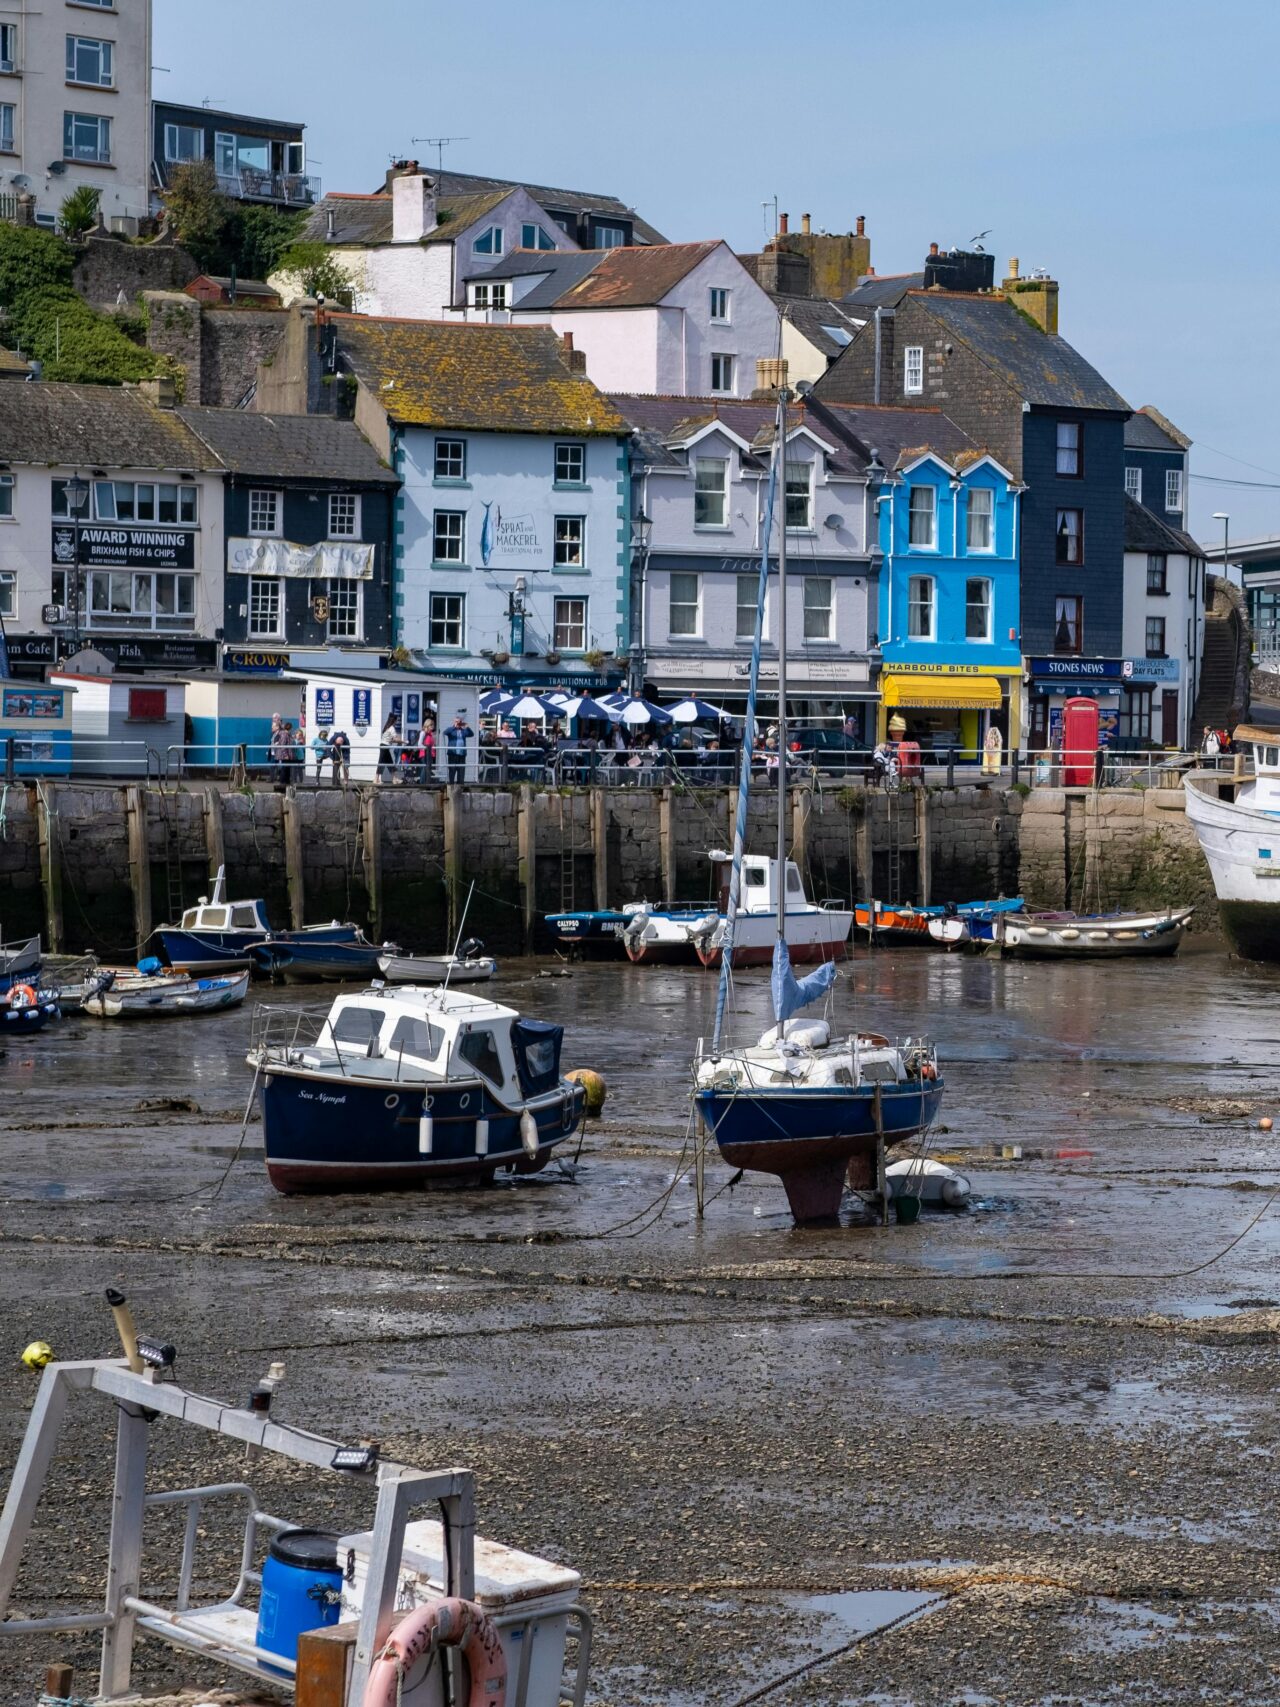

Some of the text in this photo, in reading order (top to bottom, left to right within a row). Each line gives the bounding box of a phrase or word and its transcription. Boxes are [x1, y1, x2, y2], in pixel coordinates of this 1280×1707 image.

[501, 522, 525, 534] SPRAT
[81, 529, 185, 546] AWARD WINNING
[496, 534, 540, 546] MACKEREL
[91, 546, 176, 559] BRIXHAM FISH & CHIPS
[234, 543, 291, 563] CROWN
[25, 643, 50, 655] Cafe
[119, 644, 141, 657] Fish
[232, 653, 291, 666] CROWN
[888, 663, 979, 673] HARBOUR BITES
[1048, 662, 1105, 674] STONES NEWS
[1147, 668, 1165, 676] FLATS
[549, 676, 608, 686] TRADITIONAL PUB
[557, 920, 579, 928] CALYPSO
[298, 1090, 346, 1104] Sea Nymph
